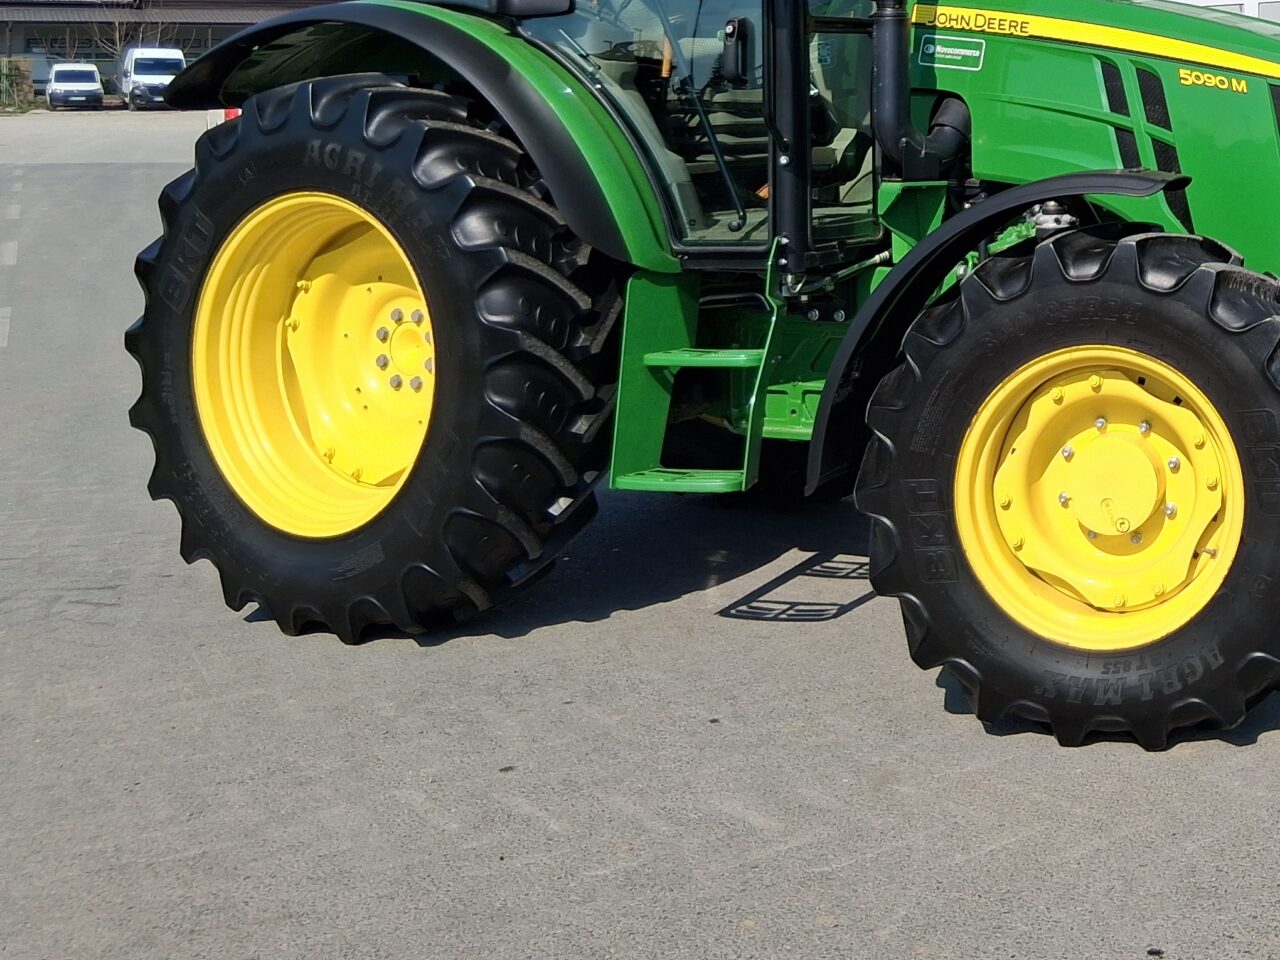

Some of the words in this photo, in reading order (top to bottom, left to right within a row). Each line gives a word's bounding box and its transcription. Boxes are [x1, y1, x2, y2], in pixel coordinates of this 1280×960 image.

[928, 8, 971, 27] JOHN
[974, 13, 1030, 34] DEERE
[1179, 68, 1229, 90] 5090
[1231, 77, 1248, 93] M
